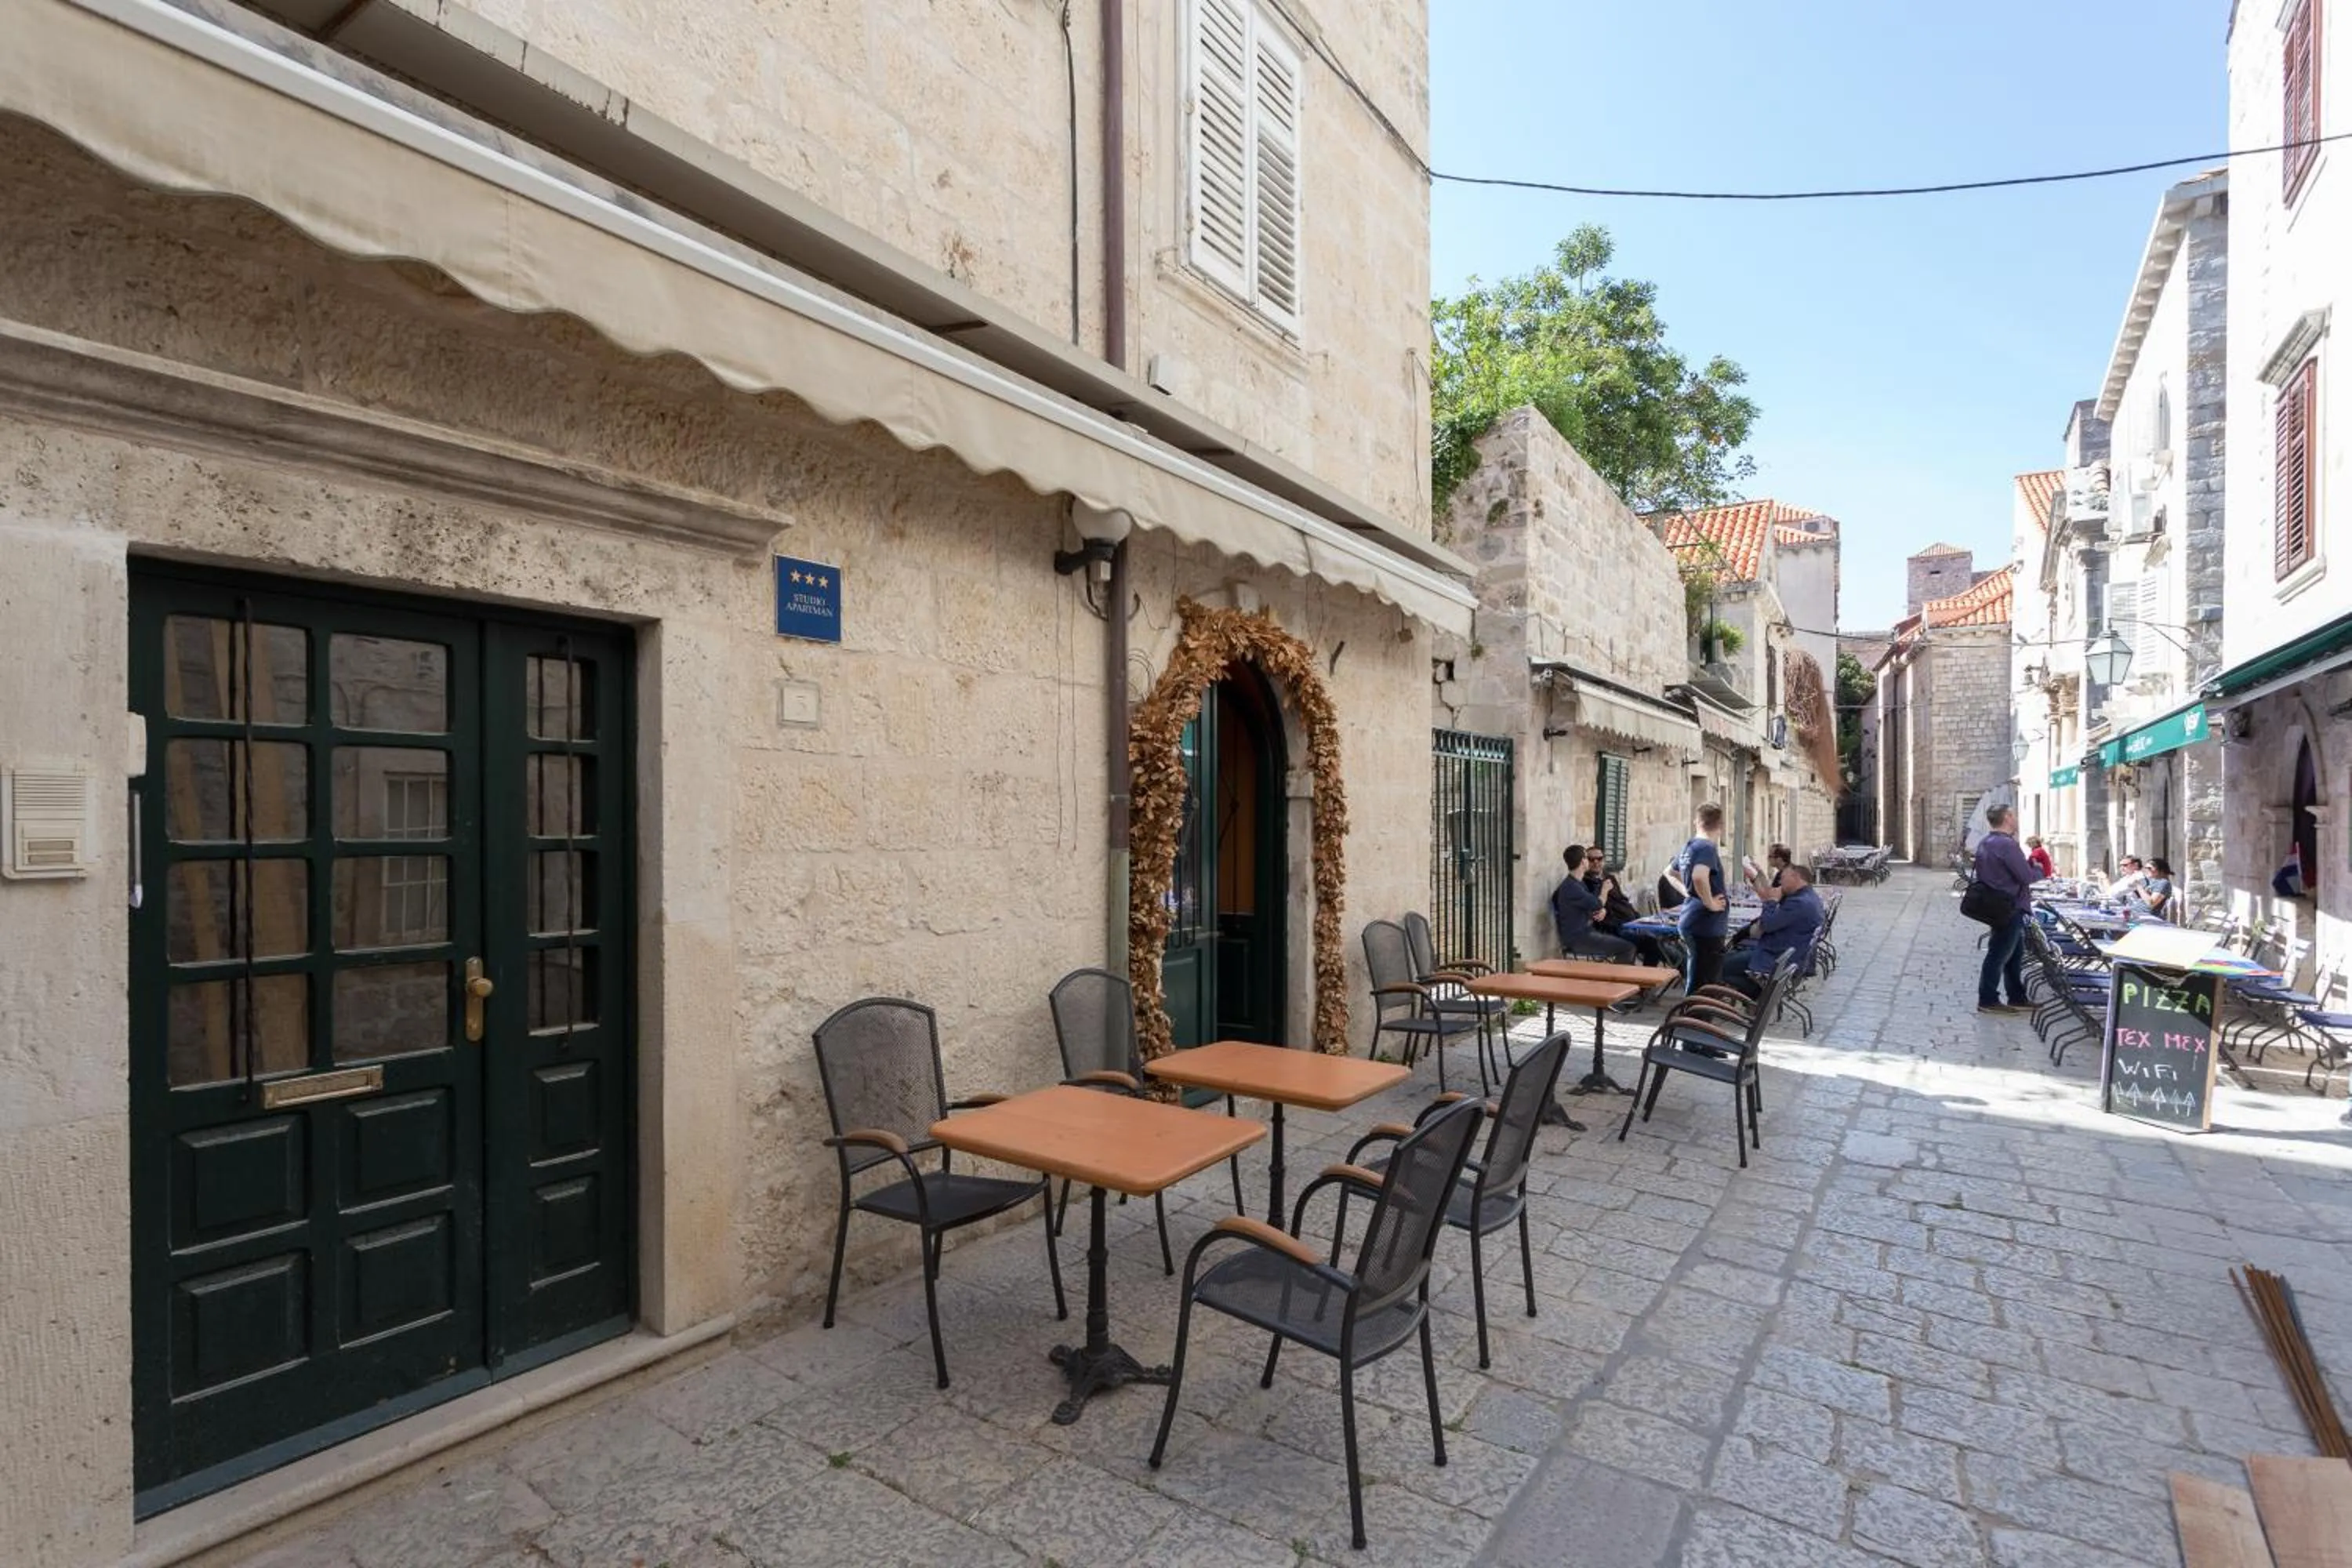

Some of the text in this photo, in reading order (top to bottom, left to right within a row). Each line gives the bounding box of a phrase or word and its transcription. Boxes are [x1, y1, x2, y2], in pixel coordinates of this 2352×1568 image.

[786, 602, 833, 617] APARTMAN
[2124, 983, 2211, 1014] PIZZA
[2115, 1028, 2206, 1054] TEX MEX
